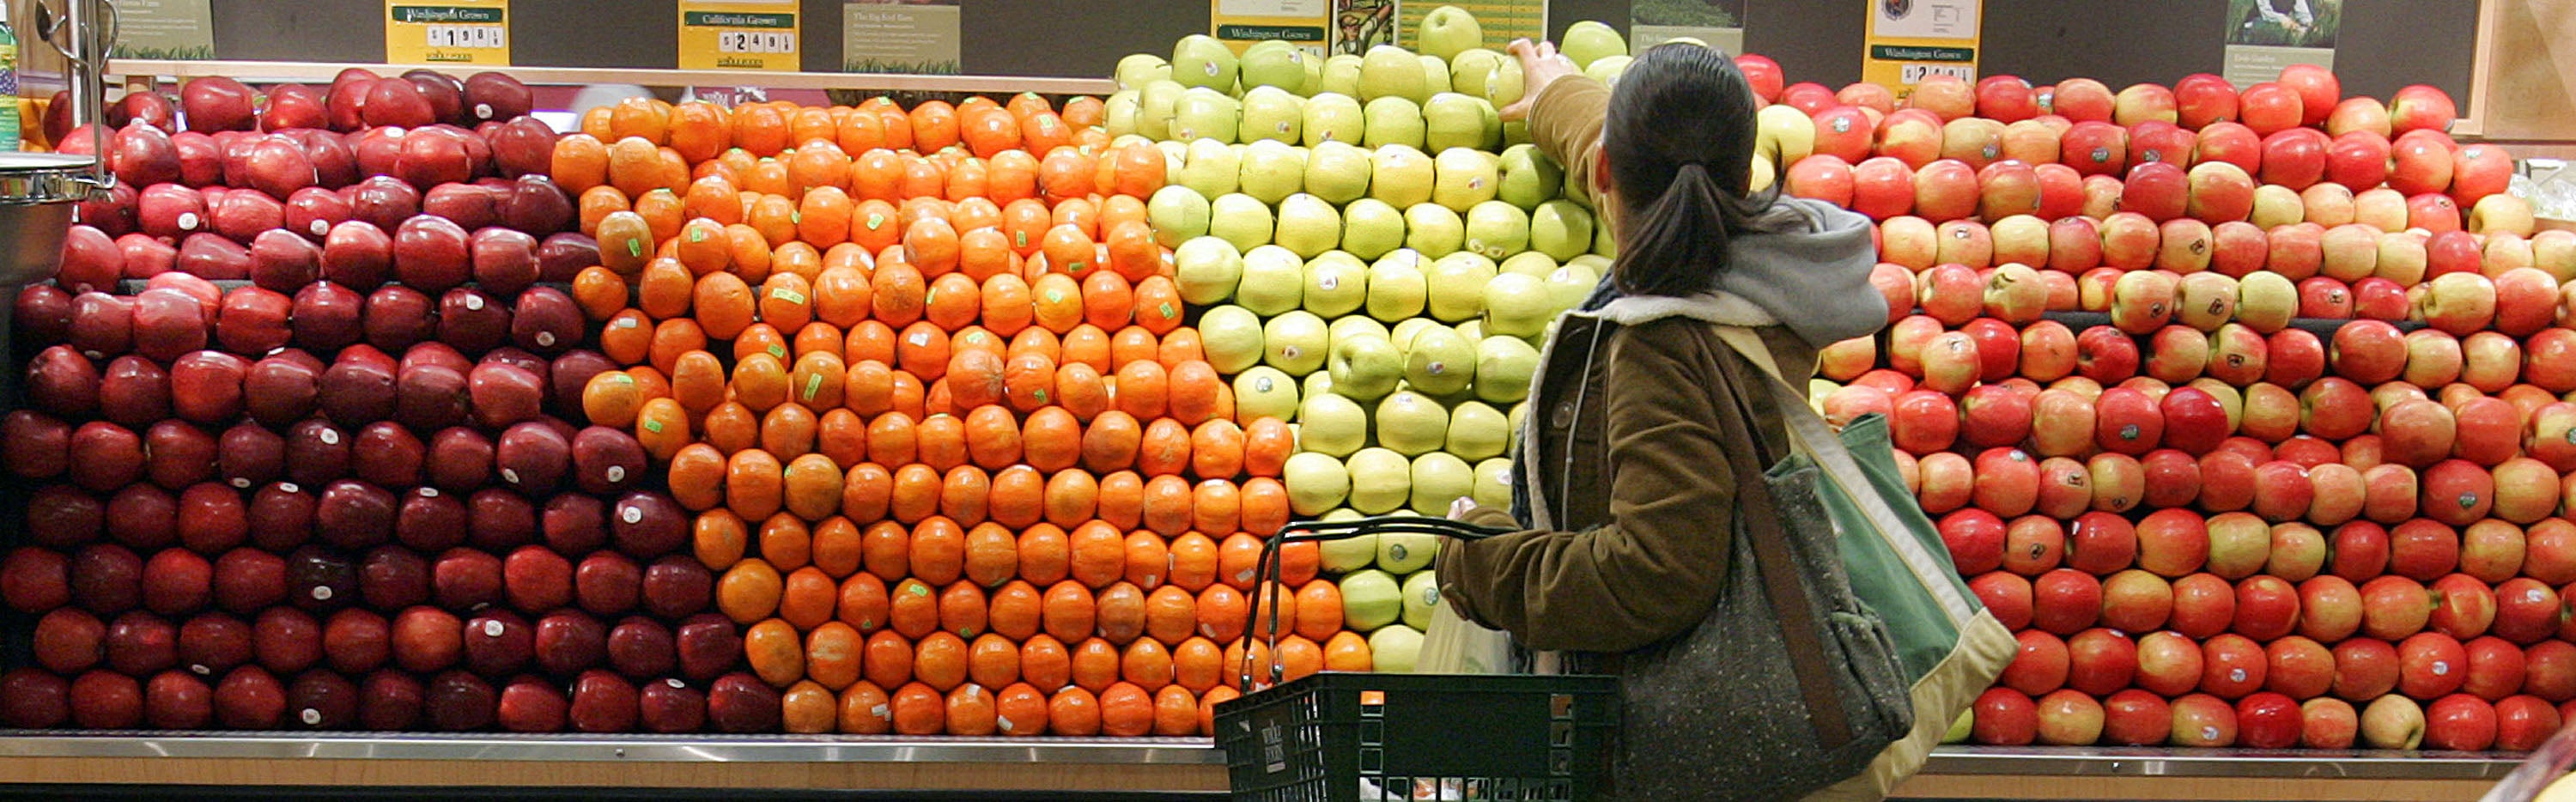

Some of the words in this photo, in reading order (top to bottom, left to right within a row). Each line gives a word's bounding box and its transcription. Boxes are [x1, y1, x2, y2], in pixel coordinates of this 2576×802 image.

[459, 9, 489, 20] Grown
[702, 14, 745, 25] California
[746, 15, 777, 26] Grown
[1230, 27, 1281, 39] Washington
[1281, 29, 1311, 39] Grown
[1884, 47, 1932, 60] Washington
[1933, 49, 1961, 59] Grown
